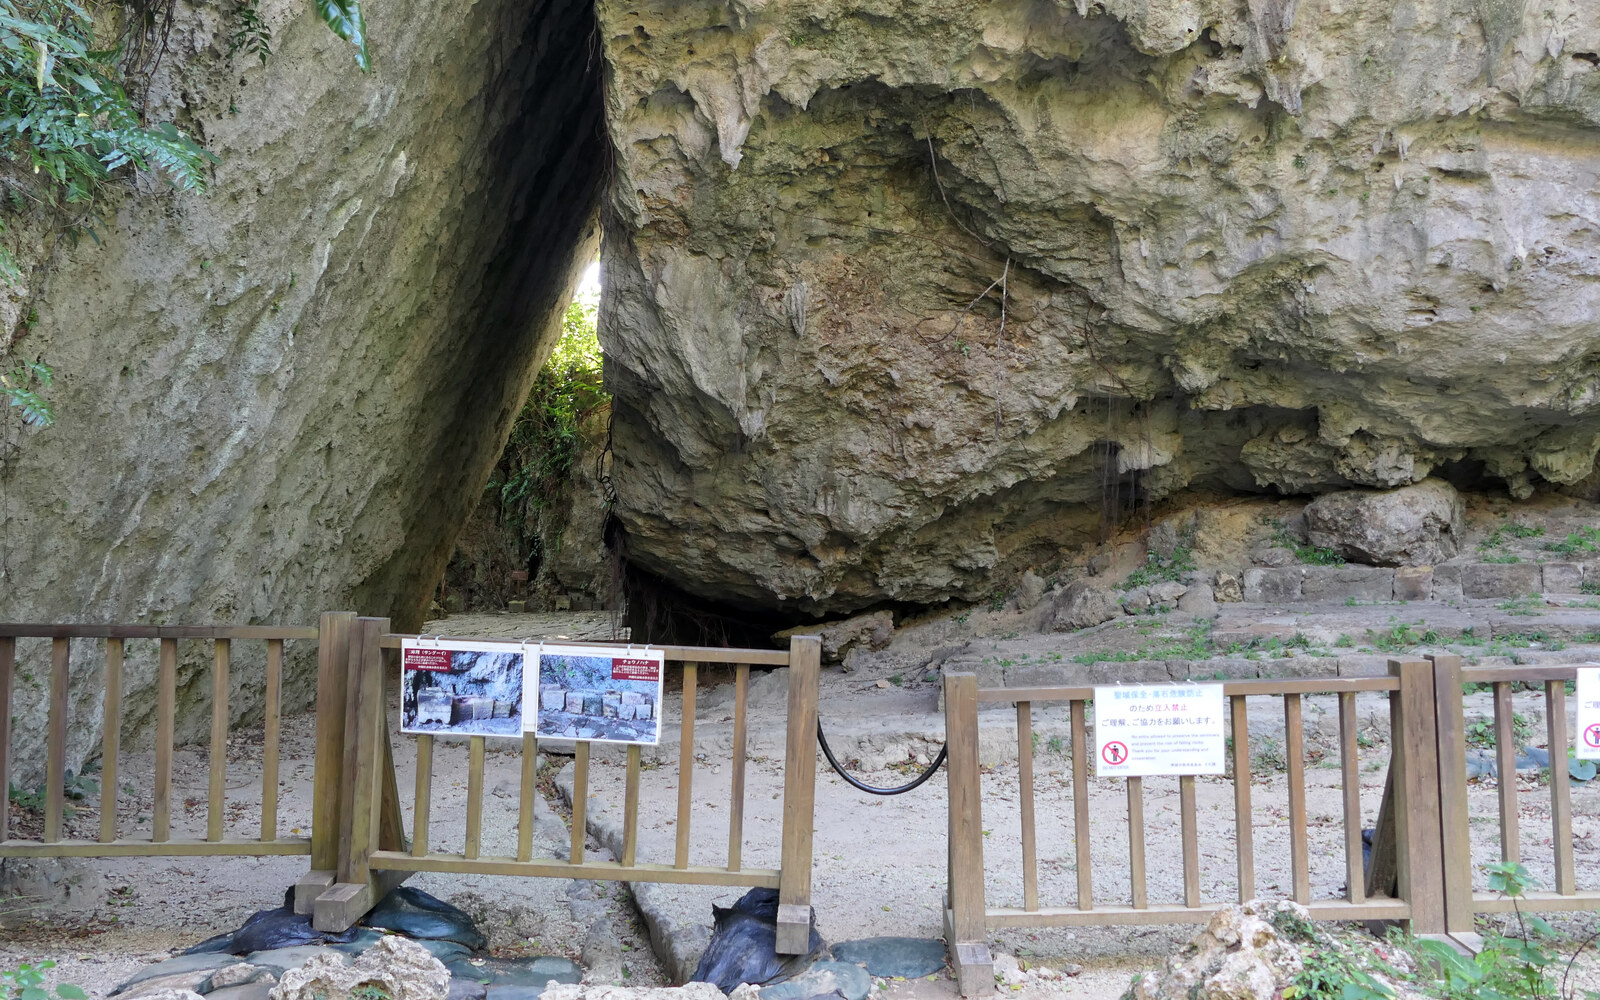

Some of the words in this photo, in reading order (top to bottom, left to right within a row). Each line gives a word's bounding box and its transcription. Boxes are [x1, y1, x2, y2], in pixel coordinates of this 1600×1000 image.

[1130, 704, 1188, 712] のため立入禁止
[1102, 716, 1215, 727] ご理解、ご協力をお願いします。
